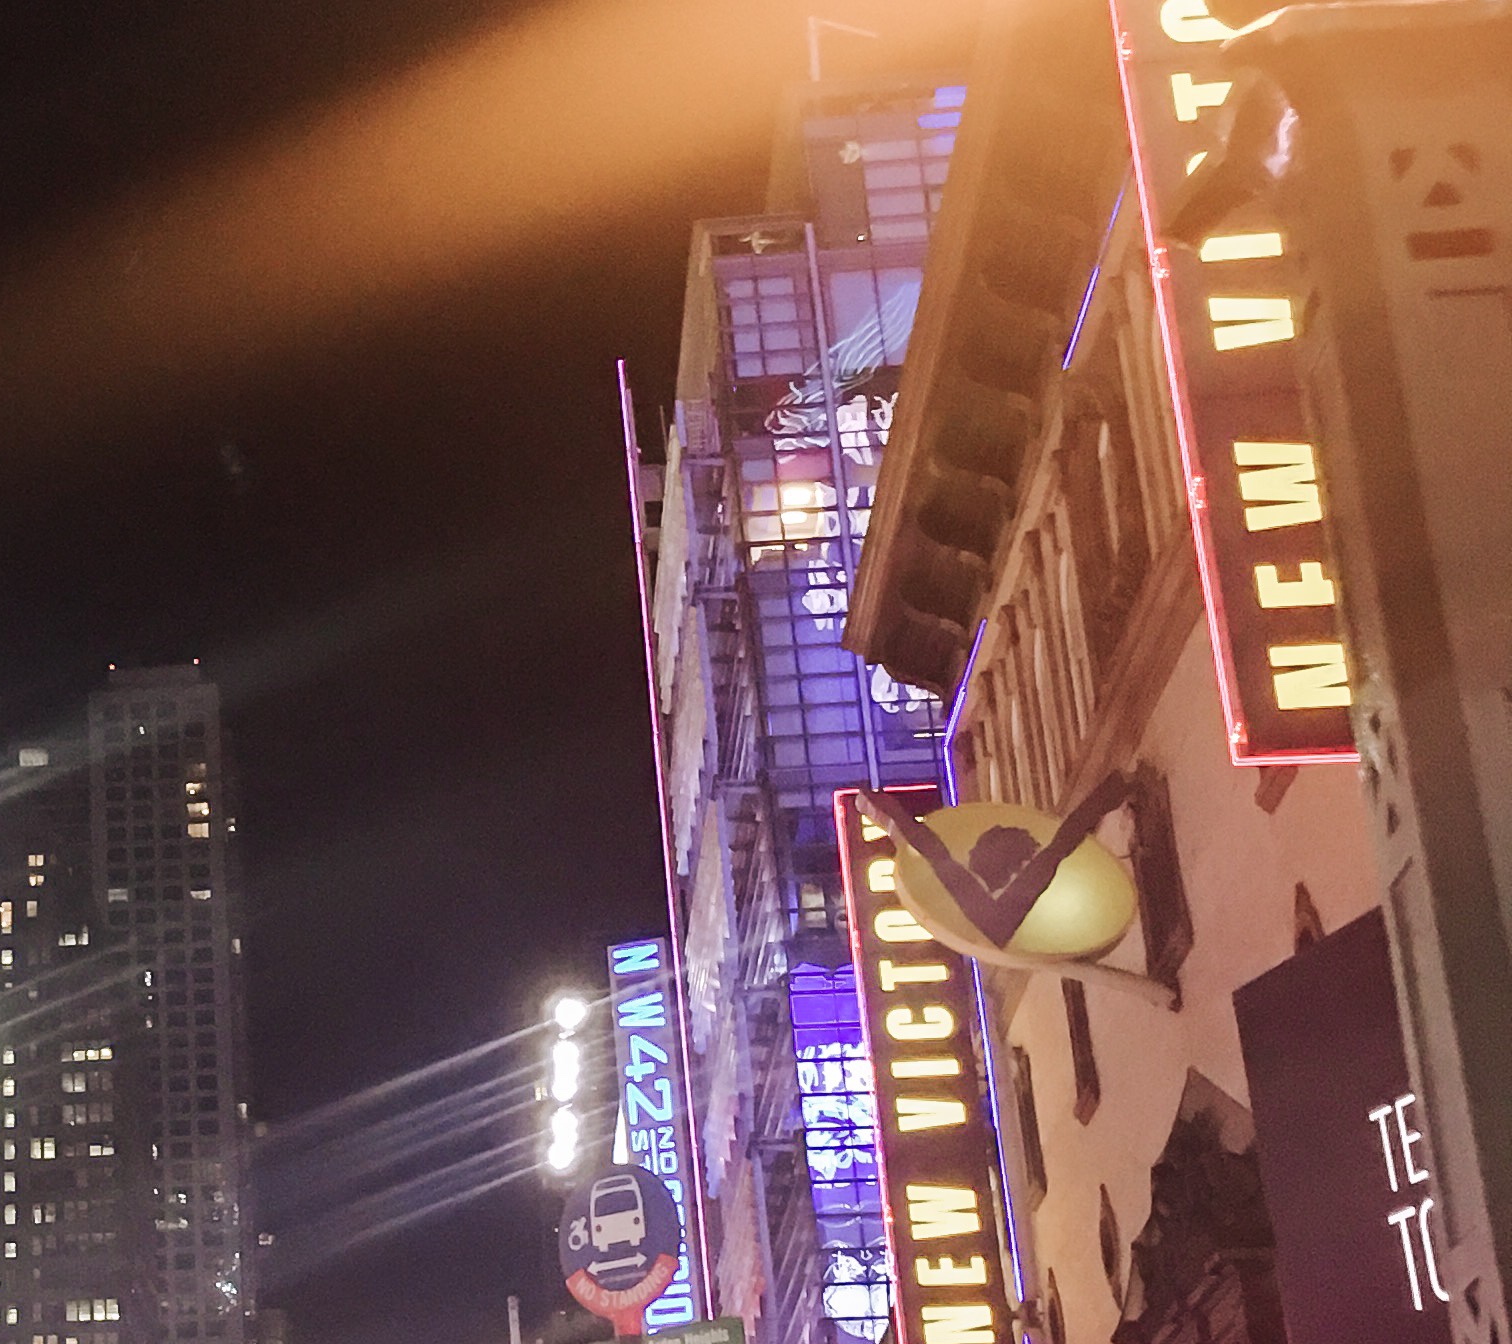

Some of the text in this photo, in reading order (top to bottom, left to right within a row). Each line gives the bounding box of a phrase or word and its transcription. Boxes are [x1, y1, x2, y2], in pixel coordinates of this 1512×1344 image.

[1232, 440, 1352, 711] NEW
[573, 1260, 670, 1308] NO STANDING
